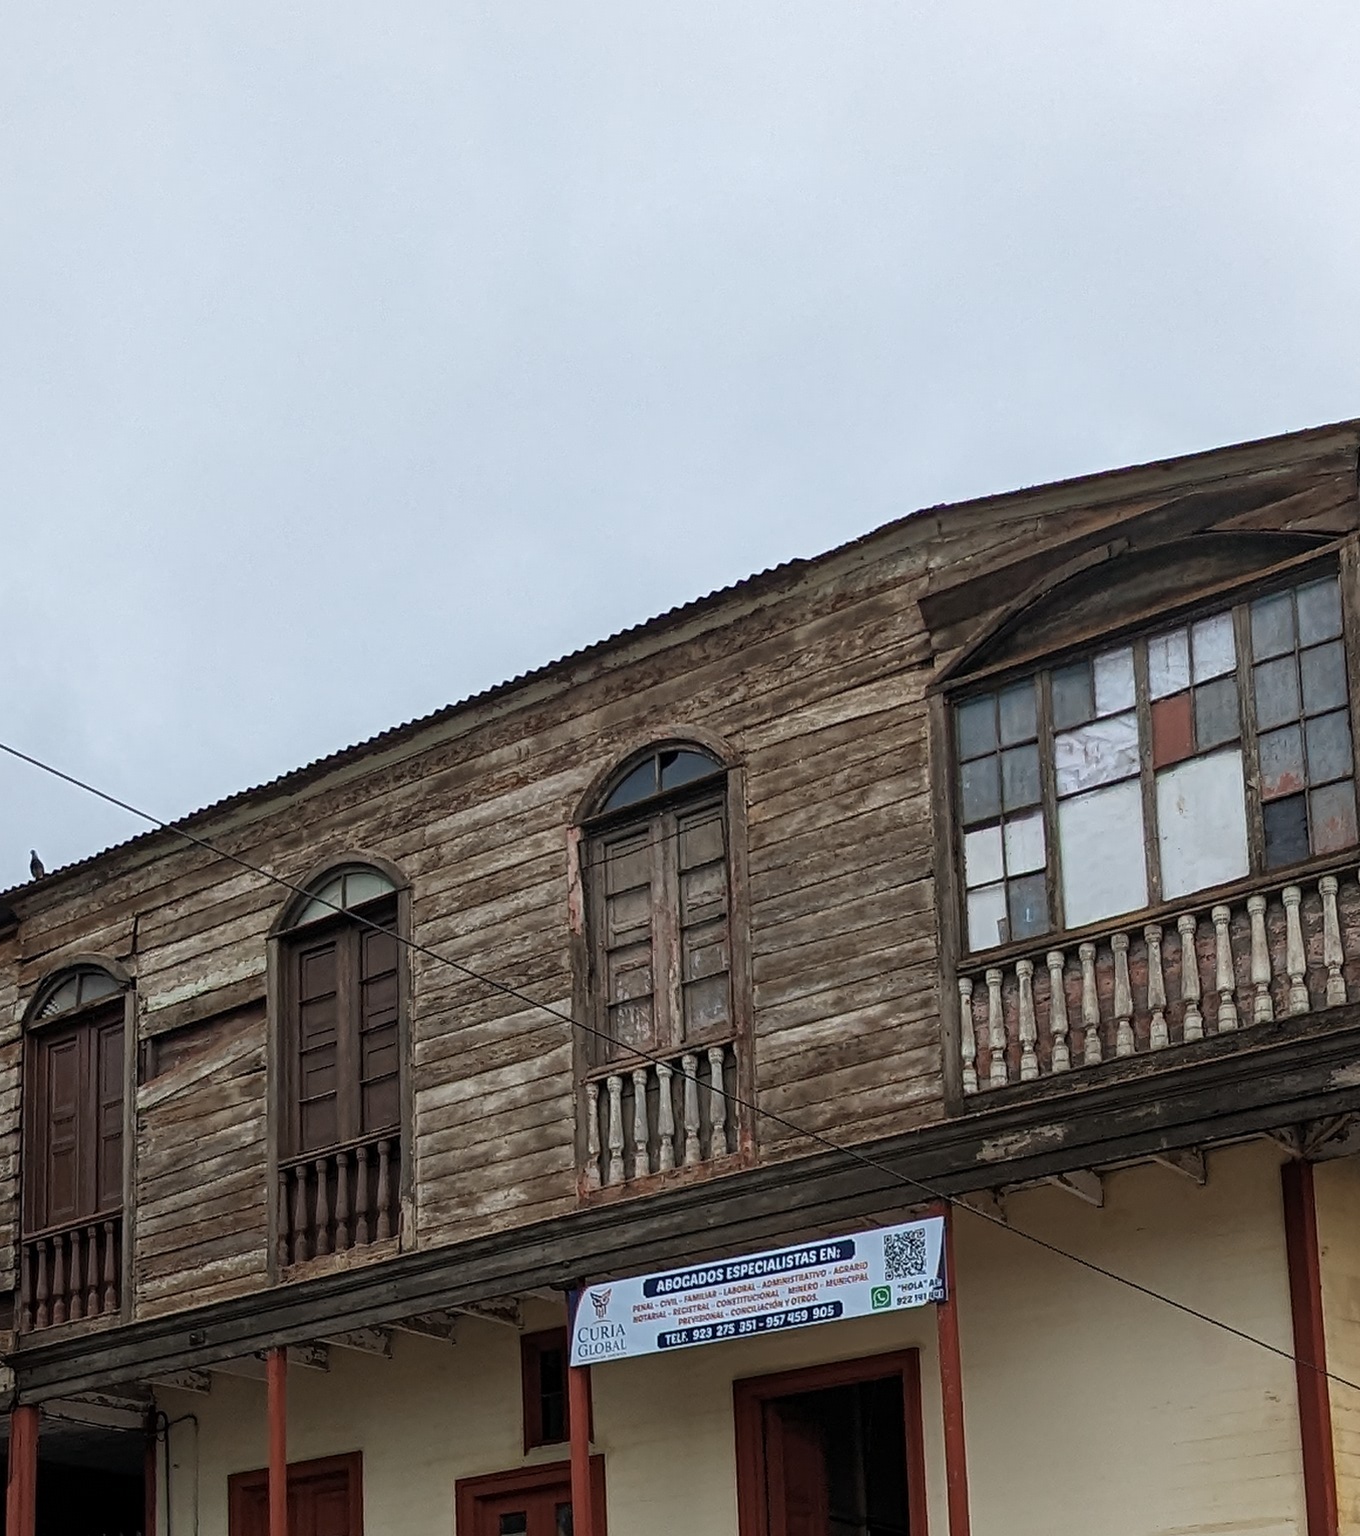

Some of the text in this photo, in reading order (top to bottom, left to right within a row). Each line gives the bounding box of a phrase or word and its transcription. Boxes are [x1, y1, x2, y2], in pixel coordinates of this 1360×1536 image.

[632, 1303, 654, 1313] PENAL
[660, 1299, 678, 1308] CIVIL
[684, 1291, 717, 1303] FAMILIAR
[723, 1283, 756, 1296] LABORAL
[761, 1269, 826, 1290] ADMINISTRATIVO
[833, 1261, 868, 1275] AGRARIO
[656, 1246, 841, 1293] ABOGADOS ESPECIALISTAS EN:
[632, 1311, 666, 1323] NOTARIAL
[673, 1303, 710, 1316] REGISTRAL
[716, 1289, 779, 1308] CONSTITUCIONAL
[788, 1282, 818, 1294] MINERO
[826, 1273, 869, 1287] MUNICIPAL
[577, 1323, 626, 1343] CURIA
[692, 1327, 713, 1341] 923
[716, 1323, 735, 1337] 275
[739, 1319, 756, 1333] 351
[766, 1314, 785, 1328] 957
[787, 1310, 808, 1323] 459
[812, 1305, 835, 1319] 905
[577, 1338, 627, 1358] GLOBAL
